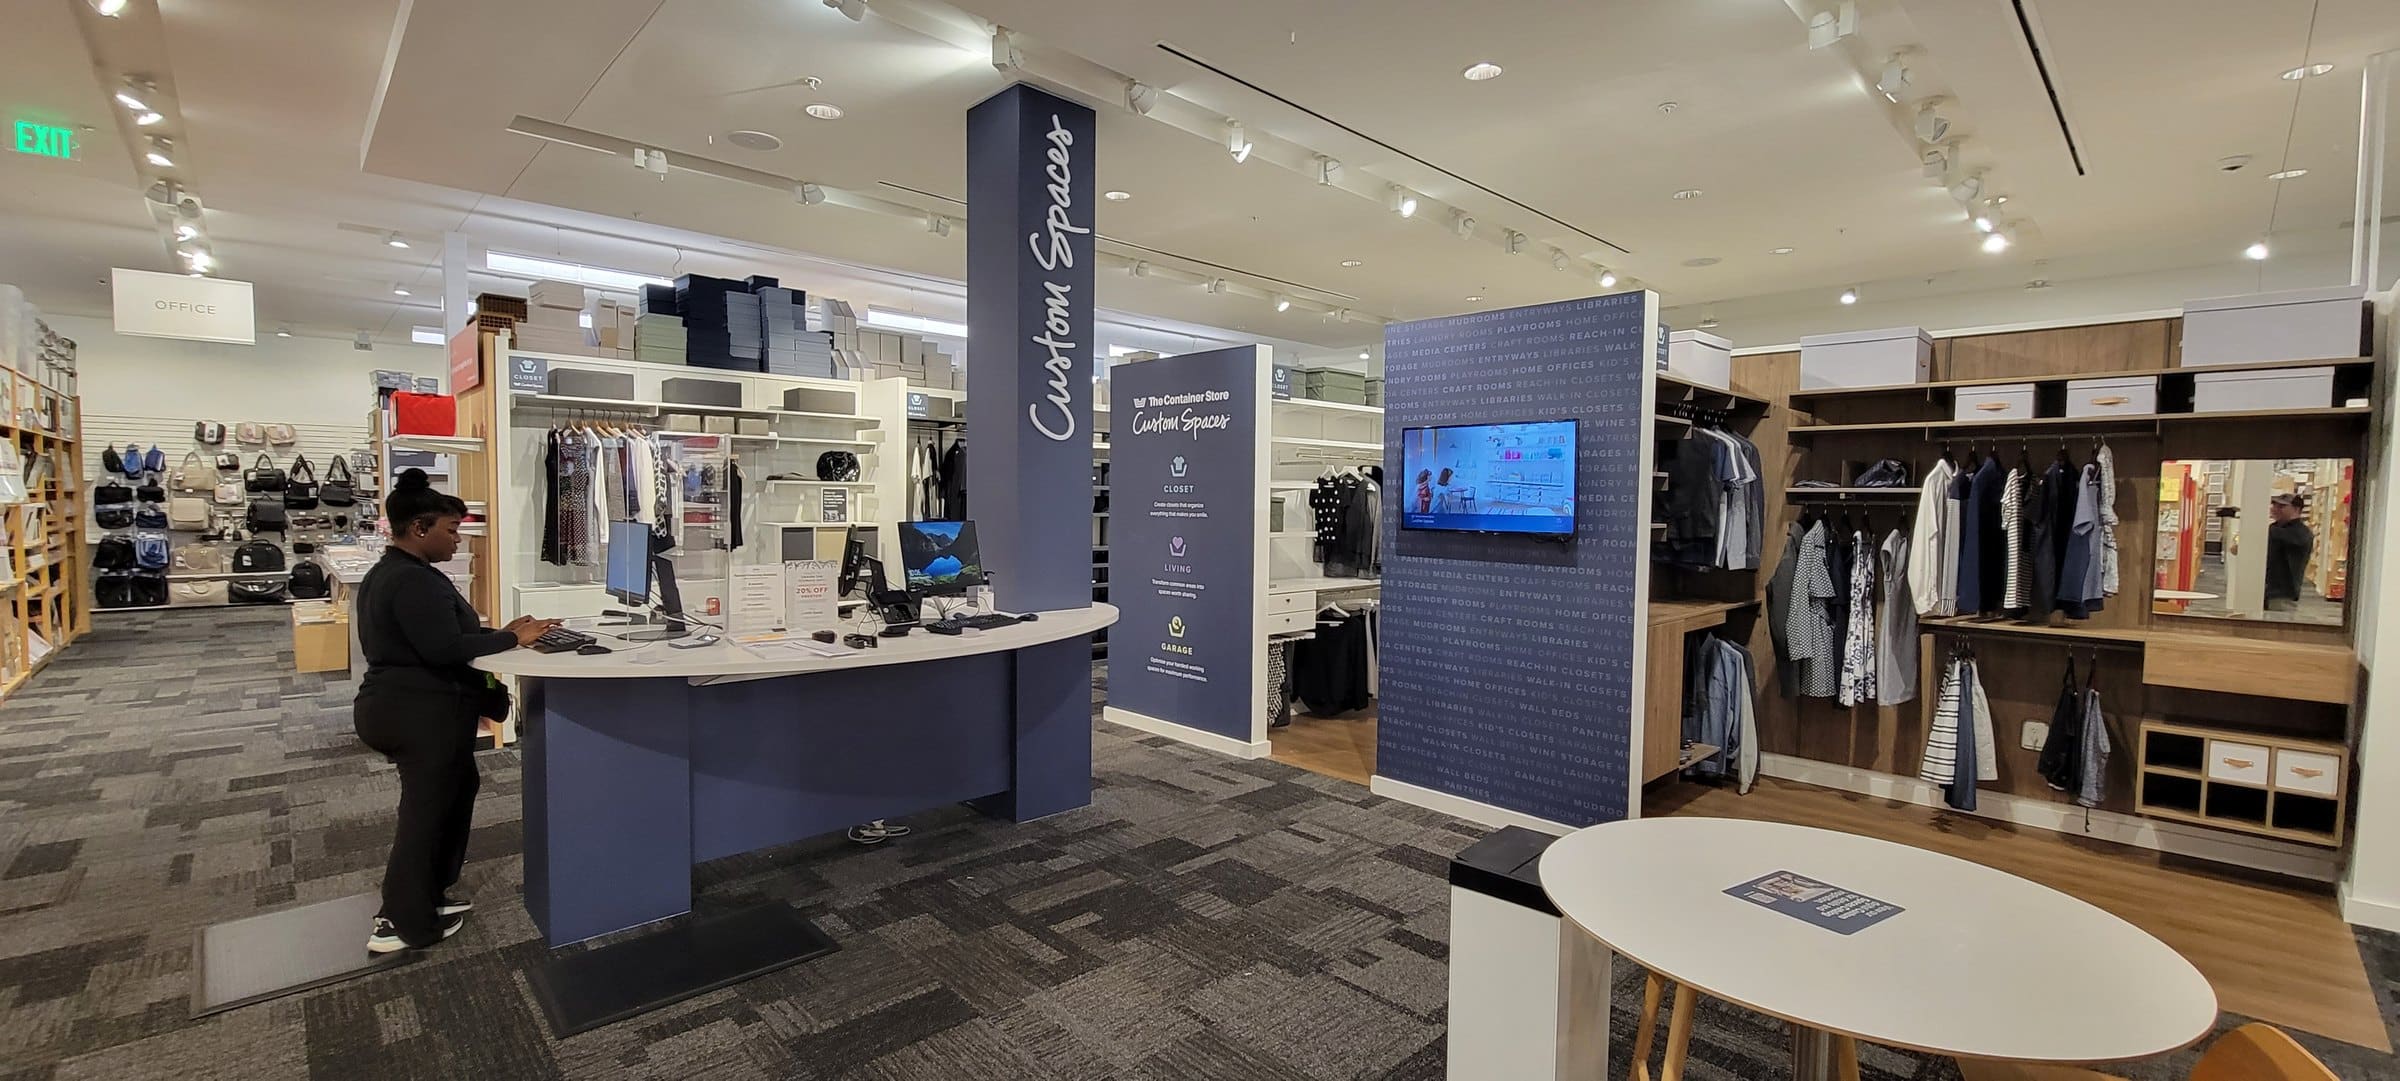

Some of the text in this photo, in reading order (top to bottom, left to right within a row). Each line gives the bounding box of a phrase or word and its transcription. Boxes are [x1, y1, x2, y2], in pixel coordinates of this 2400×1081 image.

[15, 121, 73, 159] EXIT
[1029, 113, 1090, 441] Custom Spaces
[154, 300, 217, 315] OFFICE
[1448, 312, 1505, 326] MUDROOMS
[1576, 294, 1637, 310] LIBRARIES
[1497, 319, 1561, 334] PLAYROOMS
[1411, 347, 1440, 357] MEDIA
[1443, 341, 1487, 353] CENTERS
[1568, 326, 1625, 340] REACH-IN
[1478, 350, 1539, 363] ENTRYWAYS
[1414, 372, 1446, 382] ROOMS
[1512, 364, 1543, 374] HOME
[1546, 359, 1594, 371] OFFICES
[1442, 384, 1473, 393] CRAFT
[1476, 381, 1511, 391] ROOMS
[1570, 372, 1621, 384] CLOSETS
[1148, 389, 1229, 407] The Container Store
[1480, 394, 1533, 404] LIBRARIES
[1402, 412, 1457, 422] PLAYROOMS
[1537, 406, 1567, 415] KID'S
[1571, 403, 1624, 413] CLOSETS
[1594, 418, 1625, 428] WINE
[1132, 408, 1231, 440] Custom Spaces
[1163, 485, 1195, 493] CLOSET
[1164, 563, 1192, 574] LIVING
[1432, 570, 1462, 579] MEDIA
[1465, 572, 1509, 583] CENTERS
[1534, 564, 1602, 576] PLAYROOMS
[813, 586, 829, 594] OFF
[1397, 579, 1437, 590] STORAGE
[1498, 589, 1561, 602] ENTRYWAYS
[1407, 593, 1447, 604] LAUNDRY
[1451, 597, 1485, 608] ROOMS
[1555, 608, 1587, 619] HOME
[1480, 614, 1512, 625] CRAFT
[1516, 618, 1554, 630] ROOMS
[1413, 619, 1466, 633] MUDROOMS
[1531, 634, 1589, 649] LIBRARIES
[1161, 642, 1193, 656] GARAGE
[1442, 636, 1500, 651] PLAYROOMS
[1586, 655, 1618, 667] KID'S
[1393, 642, 1432, 655] CENTERS
[1506, 658, 1557, 673] REACH-IN
[1561, 666, 1611, 682] CLOSETS
[1415, 658, 1469, 673] ENTRYWAYS
[1526, 675, 1571, 690] WALK-IN
[1575, 683, 1627, 699] CLOSETS
[1453, 677, 1481, 689] HOME
[1484, 682, 1526, 696] OFFICES
[1391, 679, 1422, 691] ROOMS
[1519, 701, 1547, 714] WALL
[1551, 707, 1579, 720] BEDS
[1425, 698, 1627, 744] LIBRARIES PANTRIES
[1477, 721, 1554, 744] KID'S CLOSETS
[1426, 723, 1467, 739] CLOSETS
[1529, 745, 1556, 758] WINE
[1560, 752, 1613, 771] STORAGE
[1436, 764, 1460, 777] WALL
[1463, 771, 1489, 784] BEDS
[1462, 744, 1505, 761] CLOSETS
[1562, 767, 1615, 786] LAUNDRY
[1514, 769, 1563, 788] GARAGES
